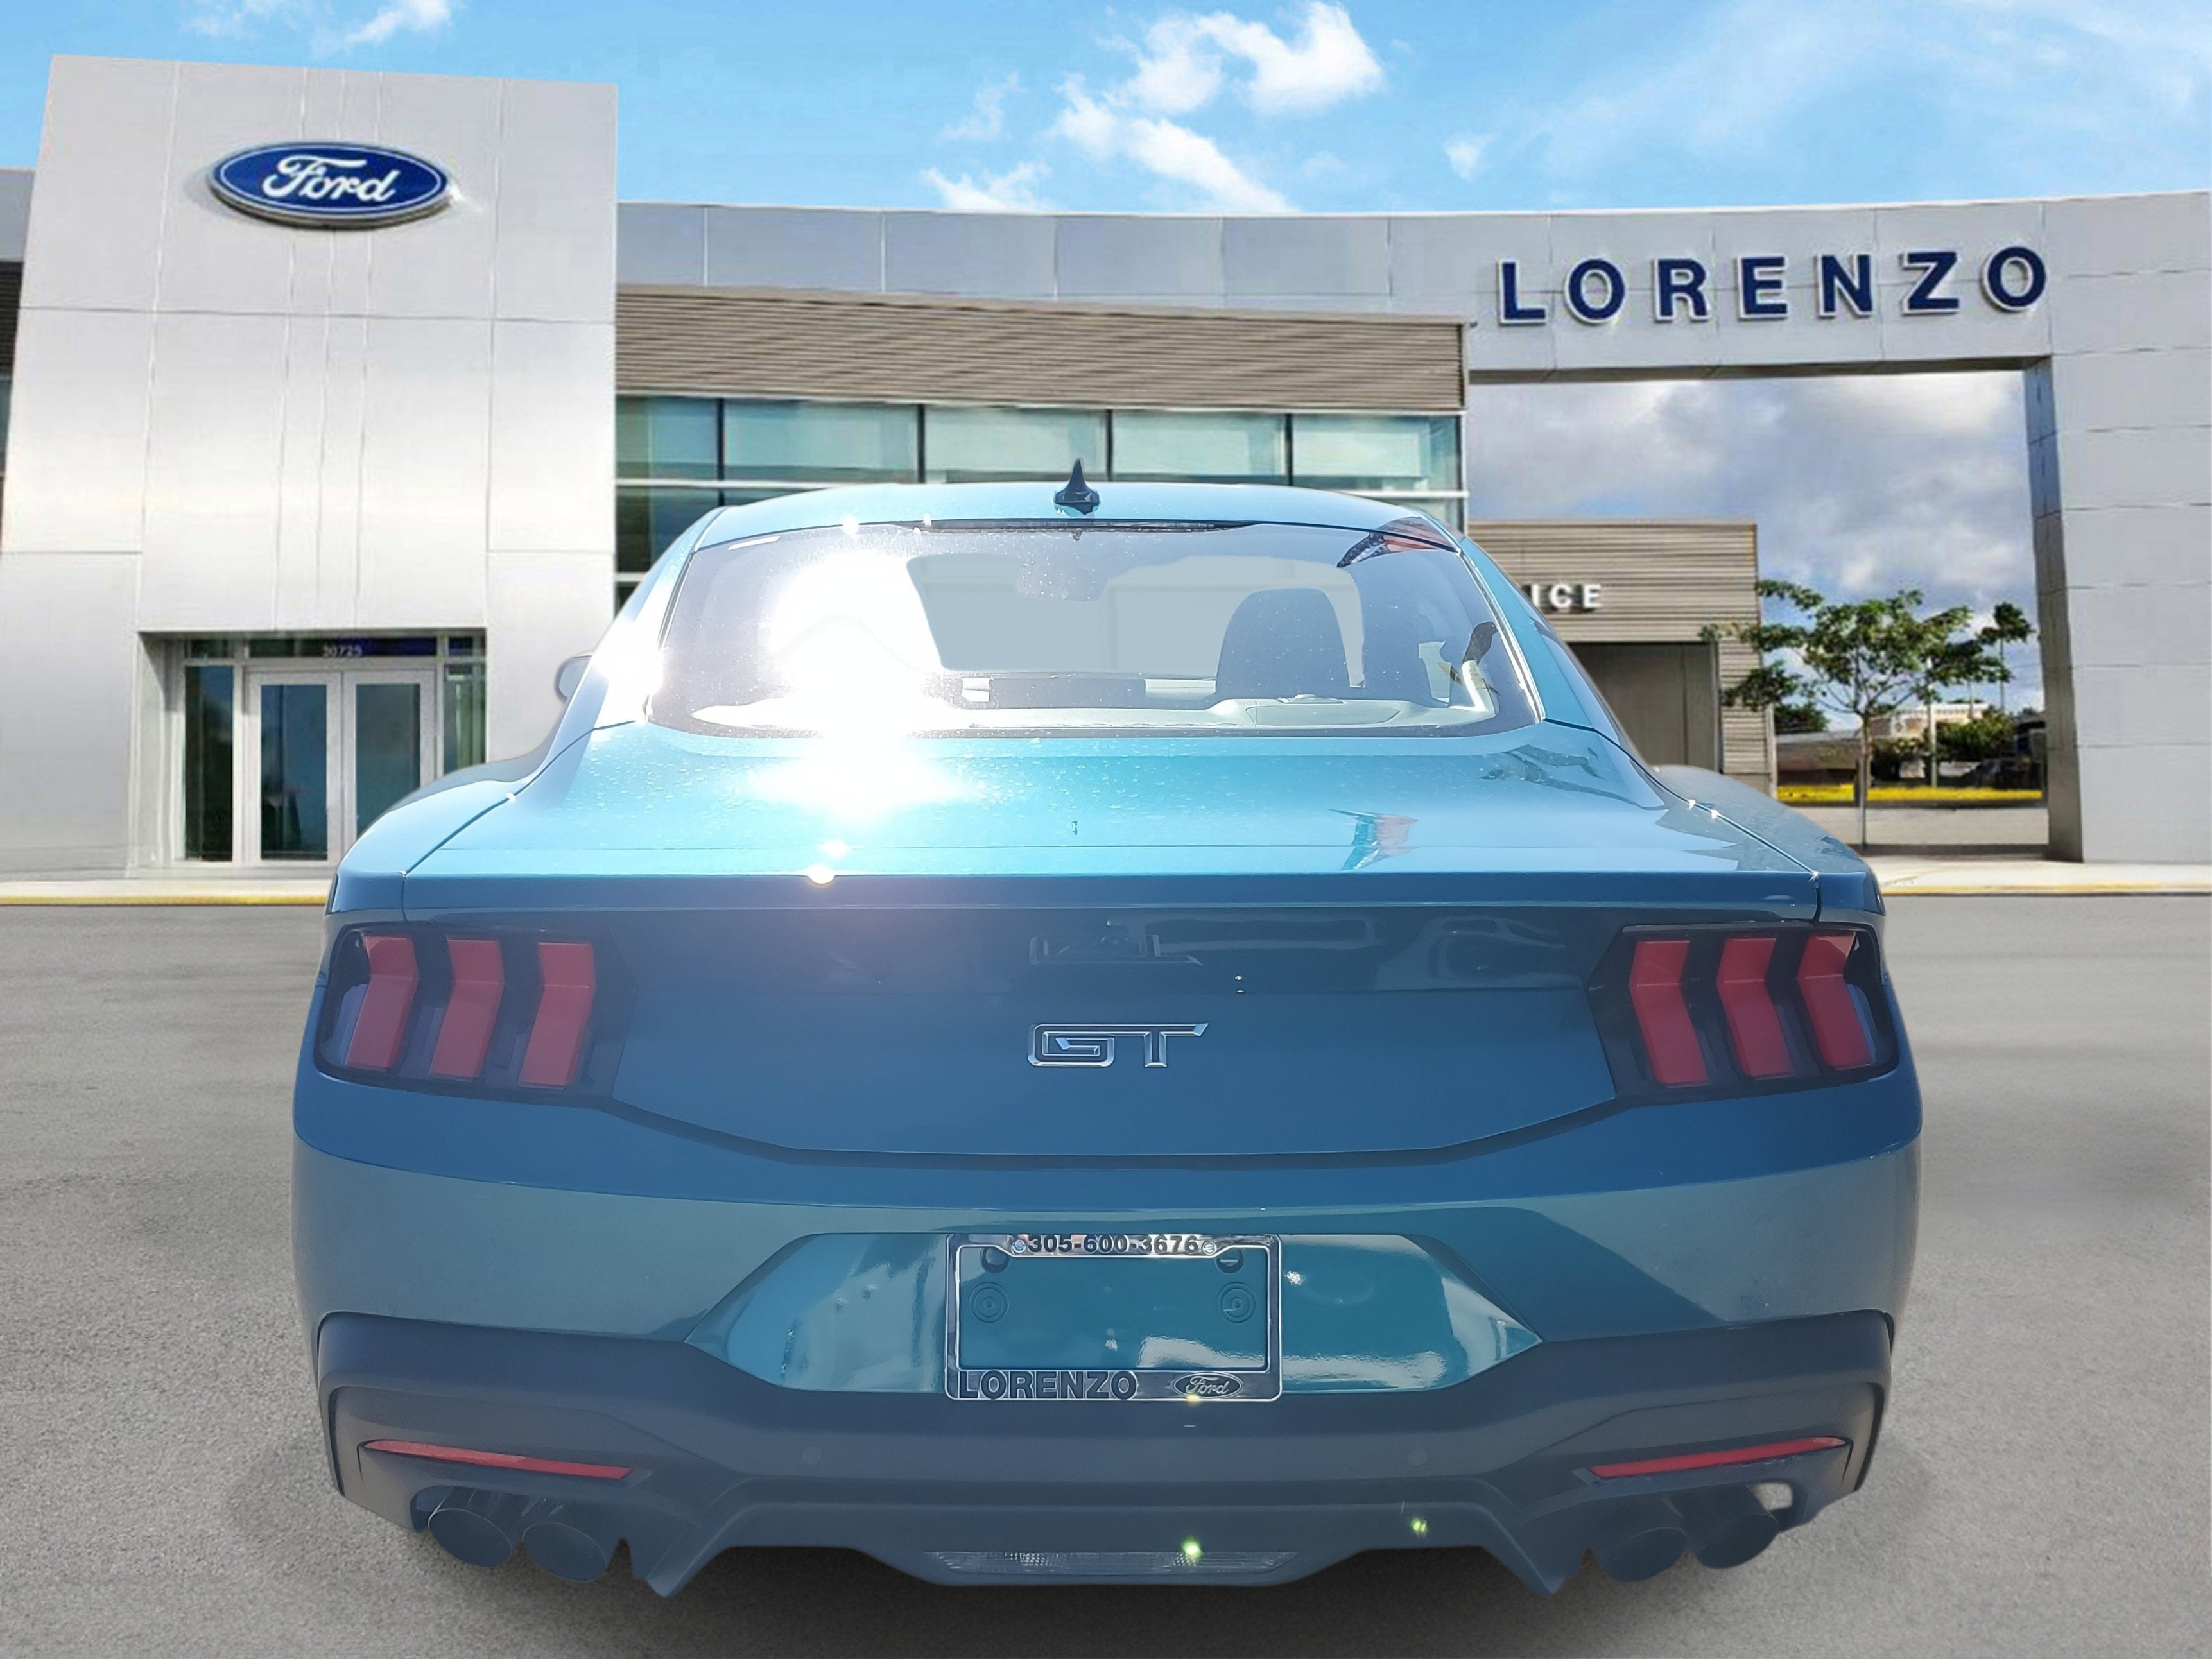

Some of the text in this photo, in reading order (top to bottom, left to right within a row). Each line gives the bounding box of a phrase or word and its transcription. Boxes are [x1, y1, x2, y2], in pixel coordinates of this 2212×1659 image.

[263, 154, 401, 202] Ford
[1498, 245, 2048, 325] LORENZO
[1028, 1022, 1209, 1067] GT
[1028, 1234, 1198, 1254] 305-600-3676
[958, 1370, 1137, 1400] LORENZO
[1185, 1375, 1230, 1395] Ford
